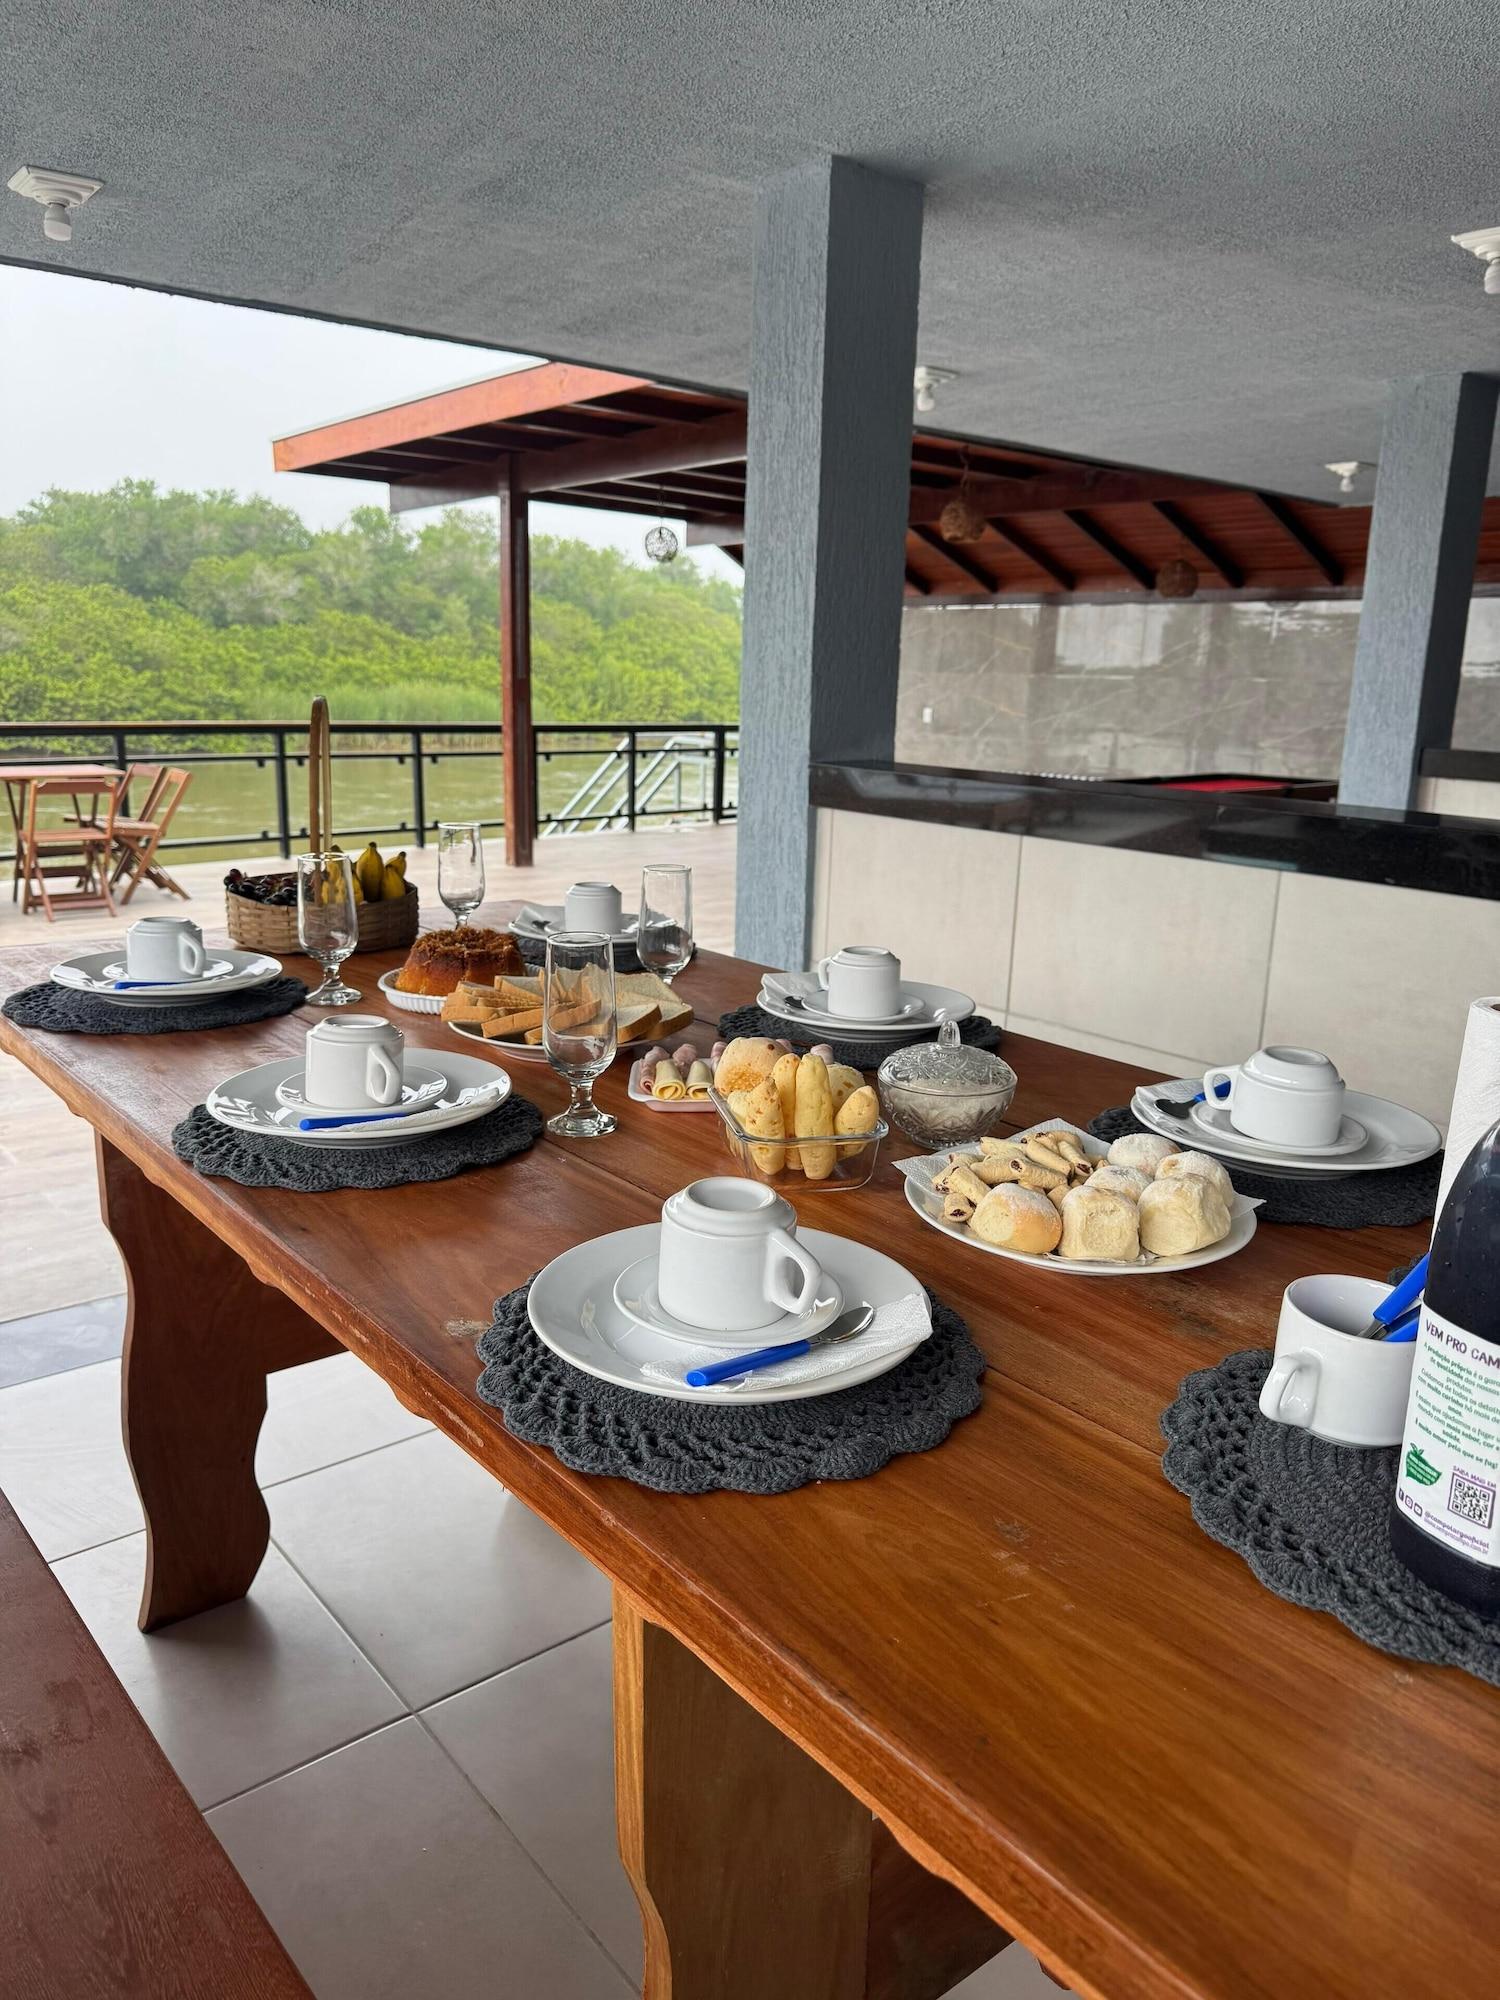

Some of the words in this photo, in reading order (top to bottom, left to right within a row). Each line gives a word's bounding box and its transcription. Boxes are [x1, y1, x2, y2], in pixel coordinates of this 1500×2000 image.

[1426, 1318, 1444, 1342] VEM
[1446, 1334, 1467, 1354] PRO
[1452, 1388, 1468, 1402] todos
